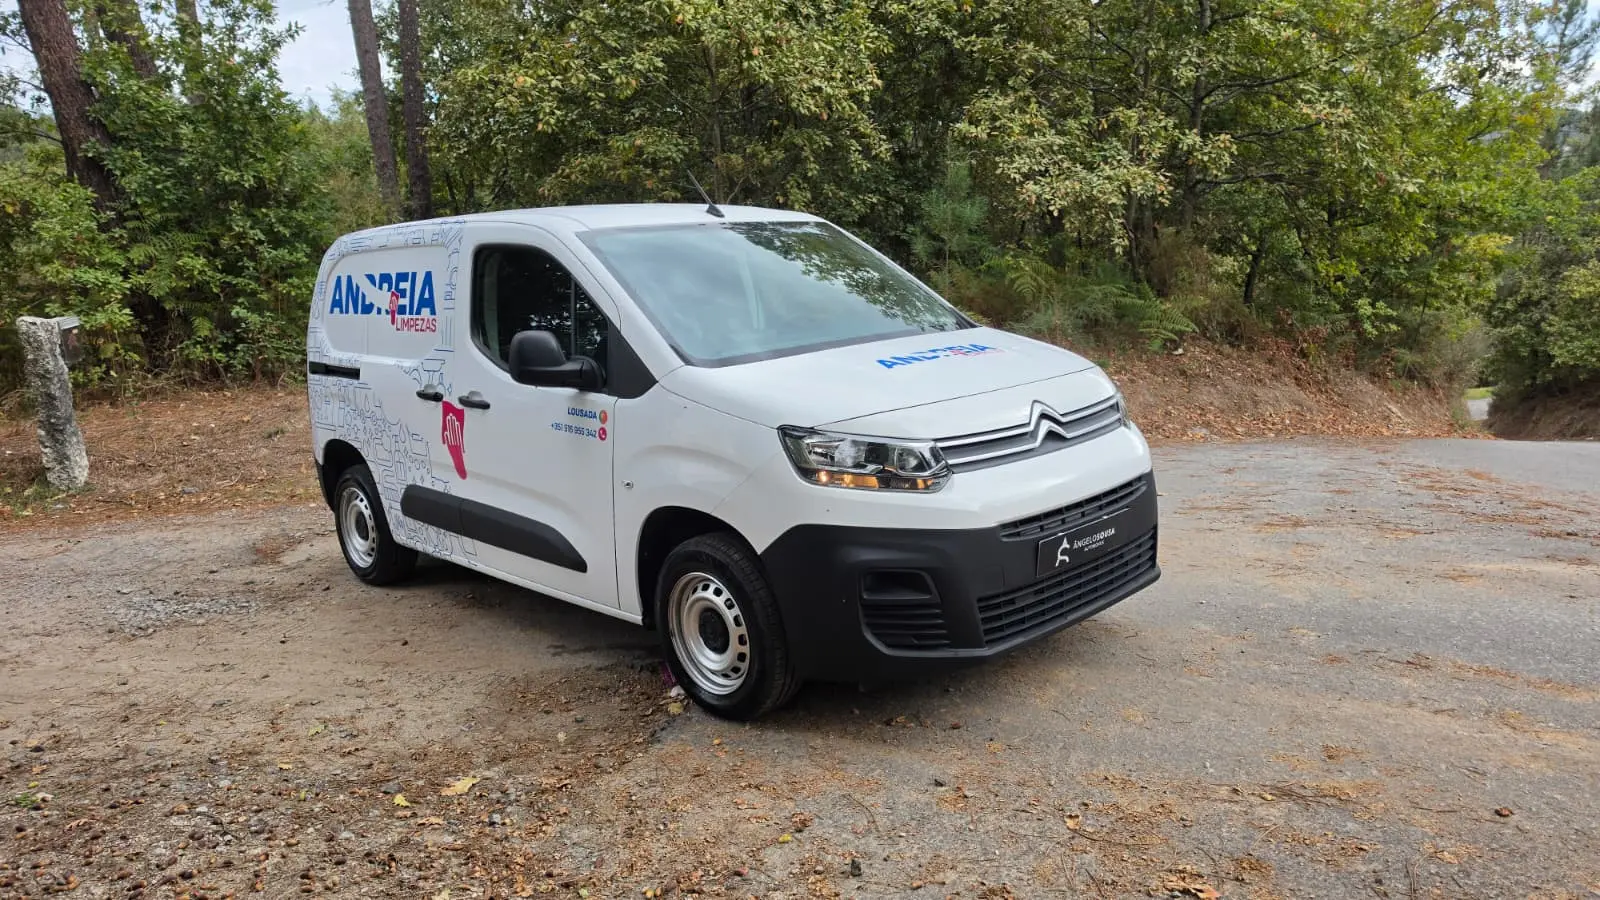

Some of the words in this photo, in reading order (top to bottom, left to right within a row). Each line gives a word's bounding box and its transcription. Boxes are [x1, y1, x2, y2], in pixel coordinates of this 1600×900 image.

[329, 270, 436, 316] ANDREIA
[395, 317, 437, 333] LIMPEZAS
[567, 406, 598, 421] LOUSADA
[585, 428, 597, 438] 342
